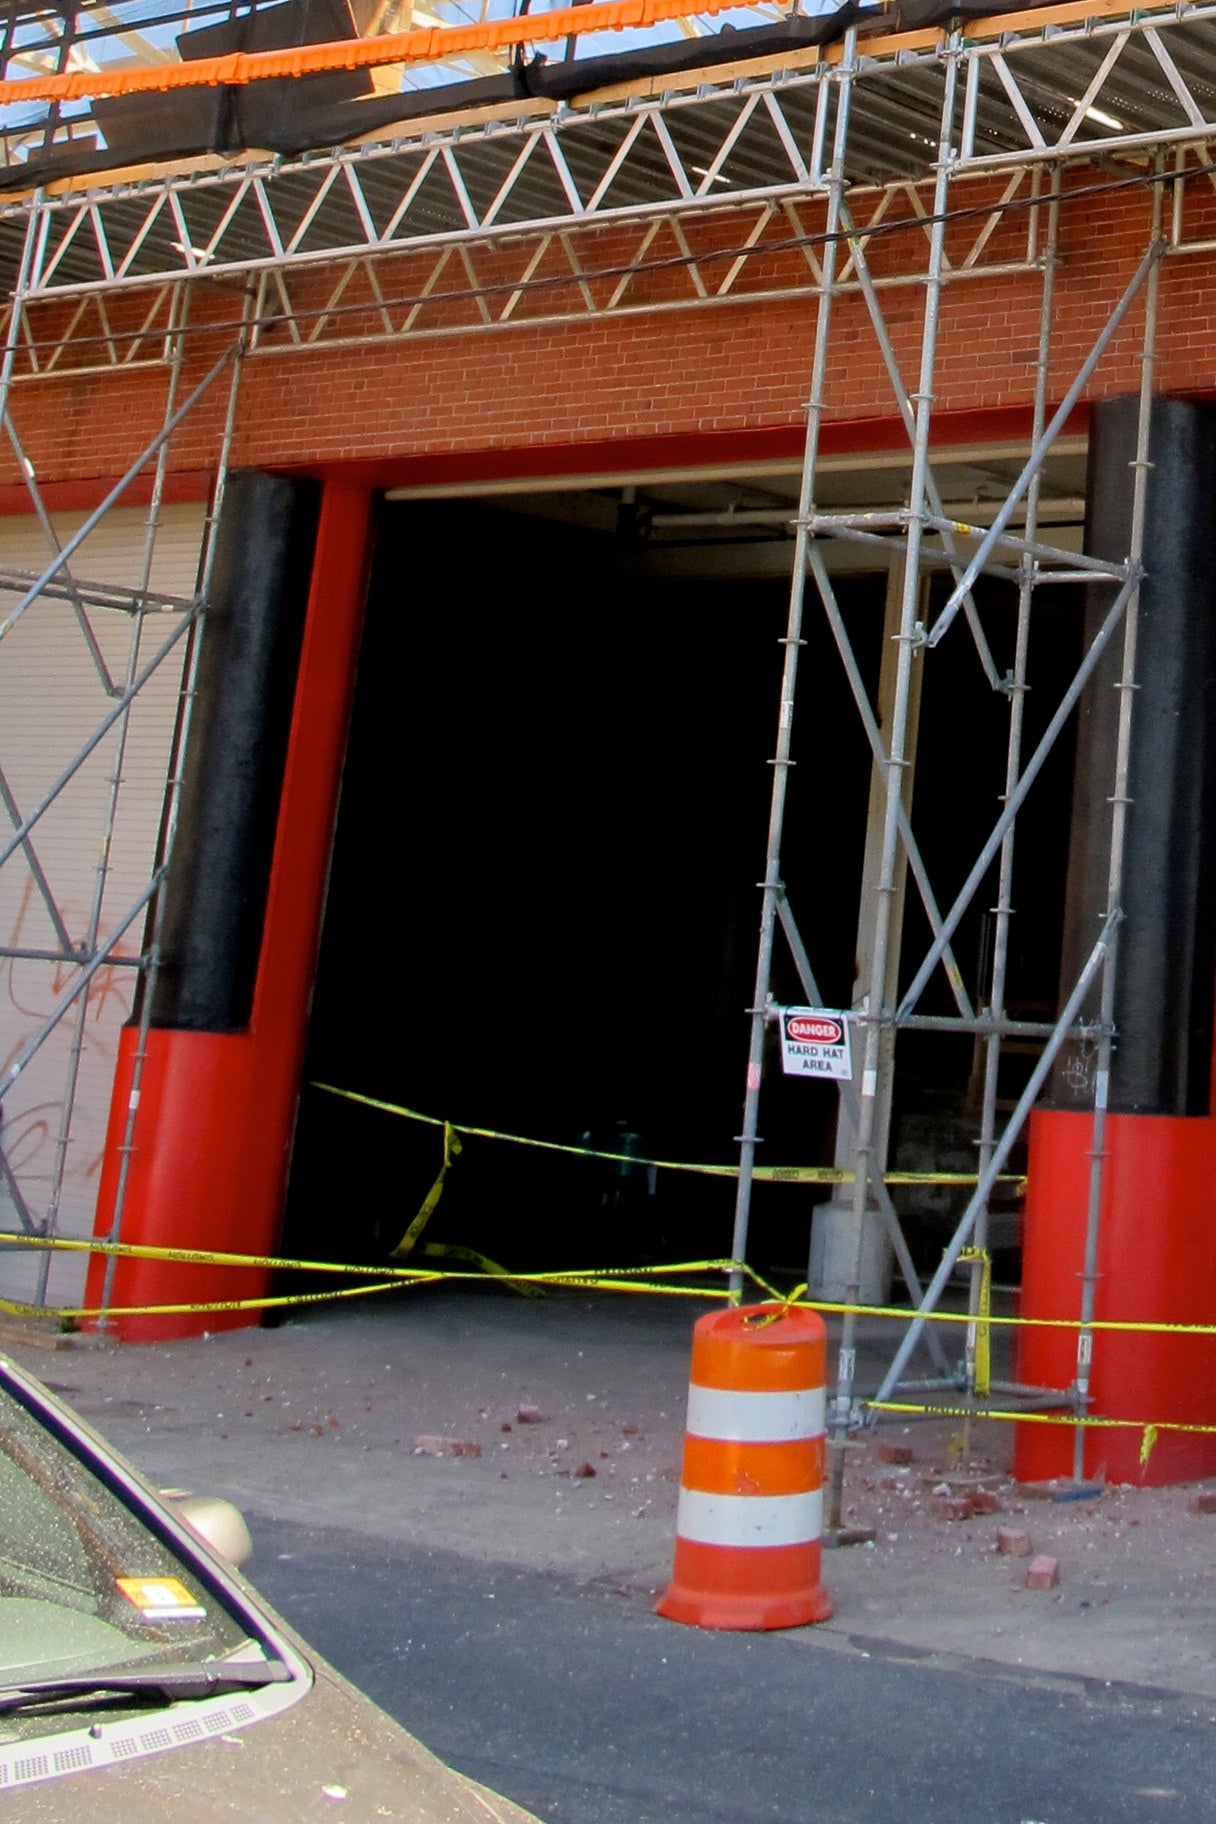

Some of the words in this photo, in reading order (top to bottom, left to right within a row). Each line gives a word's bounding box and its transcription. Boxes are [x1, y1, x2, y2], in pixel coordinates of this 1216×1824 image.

[792, 1022, 836, 1037] DANGER
[788, 1045, 818, 1057] HARD
[823, 1048, 844, 1059] HAT
[802, 1059, 832, 1072] AREA
